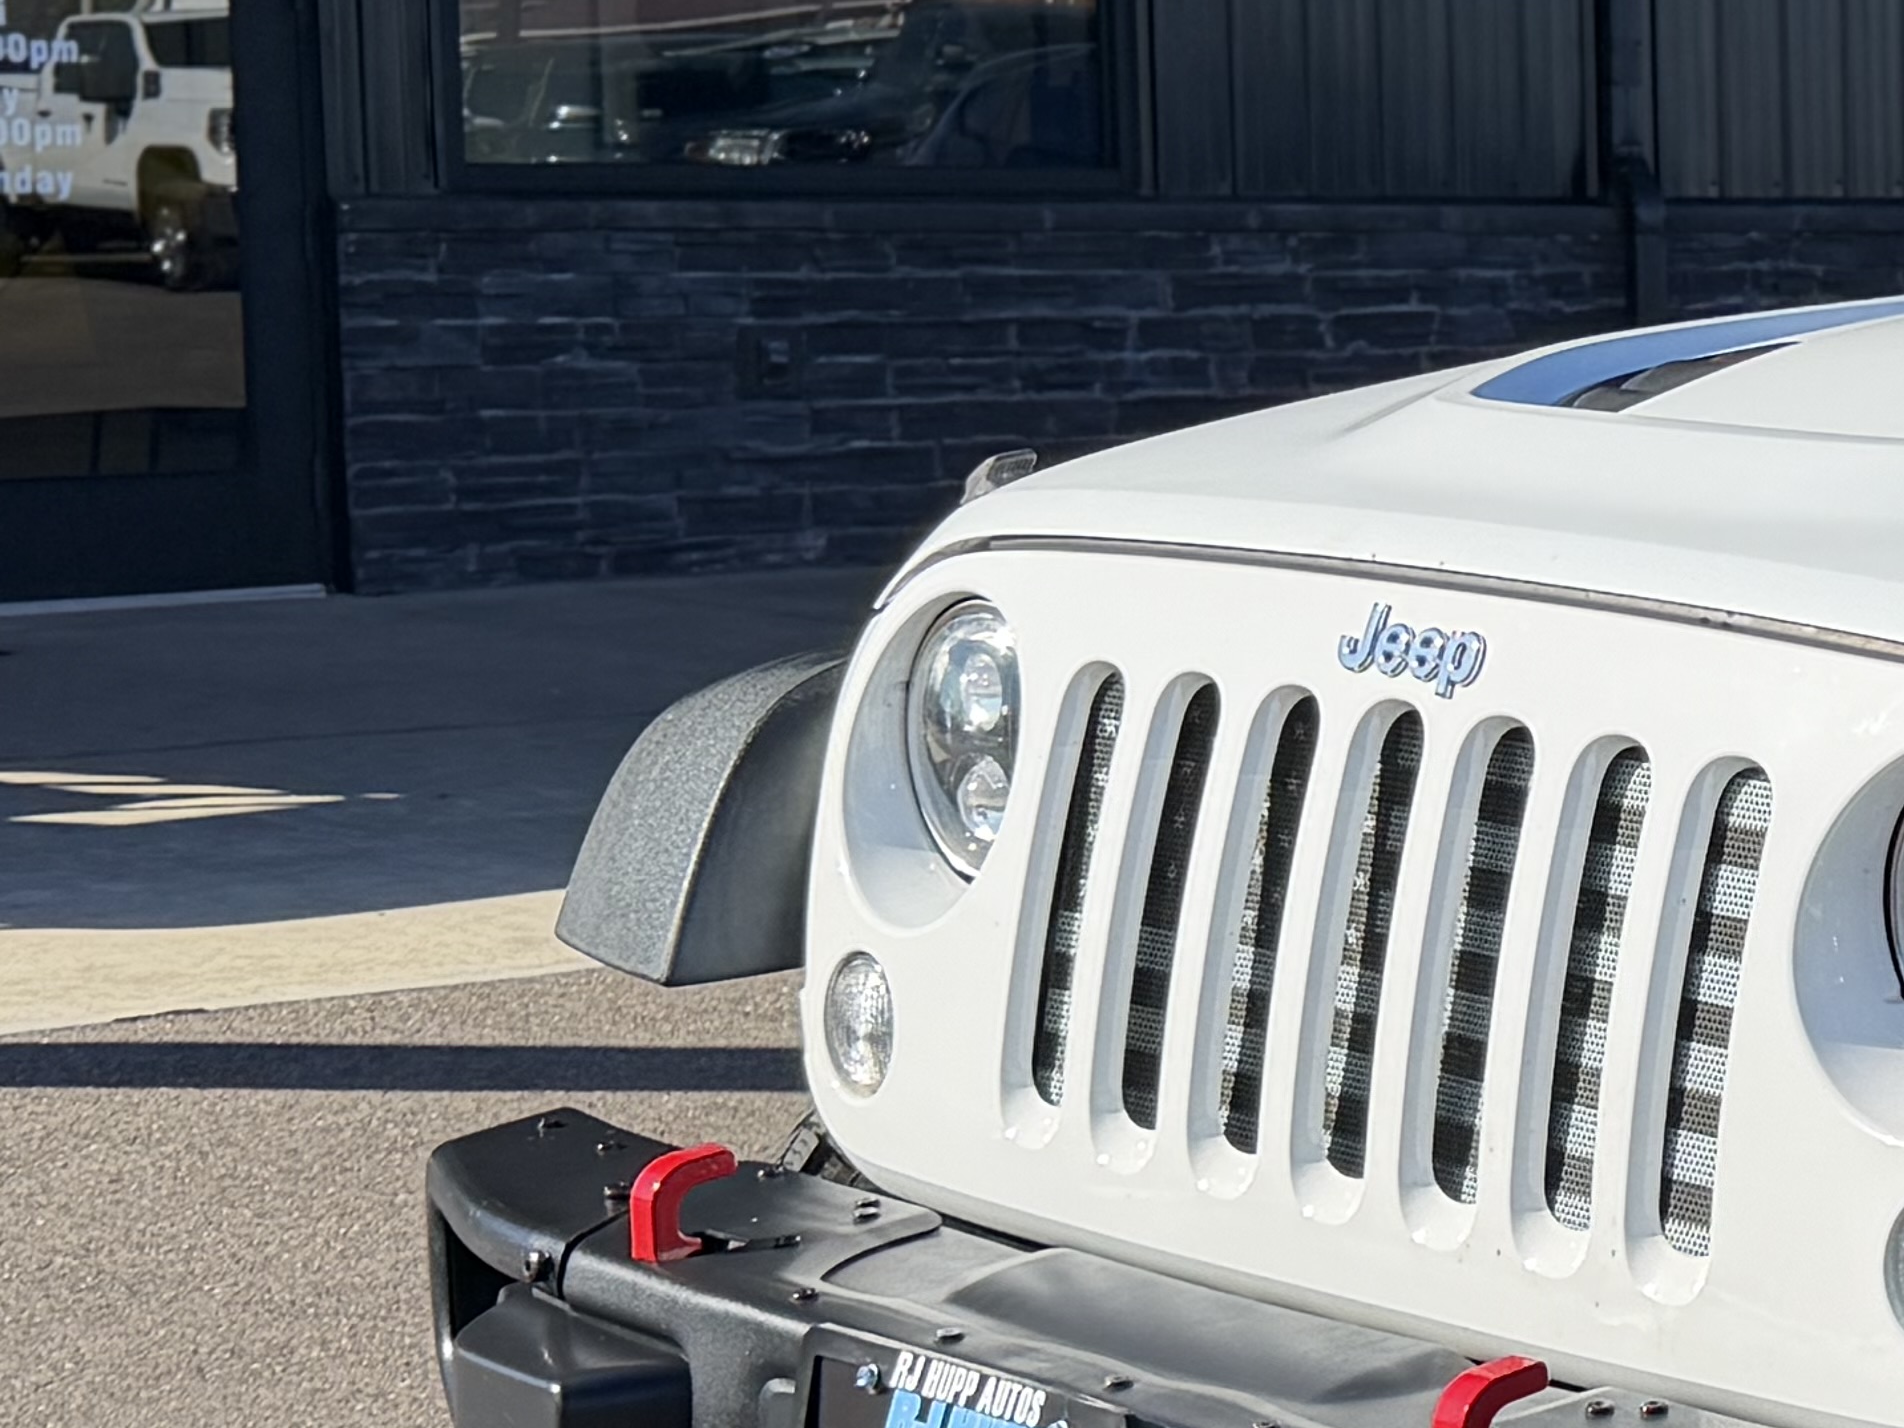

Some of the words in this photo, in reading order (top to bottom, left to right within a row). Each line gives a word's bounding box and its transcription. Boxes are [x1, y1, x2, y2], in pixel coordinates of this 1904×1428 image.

[1337, 601, 1488, 700] Jeep
[889, 1350, 926, 1392] RJ
[921, 1358, 981, 1408] HUPP
[975, 1375, 1047, 1428] AUTOS
